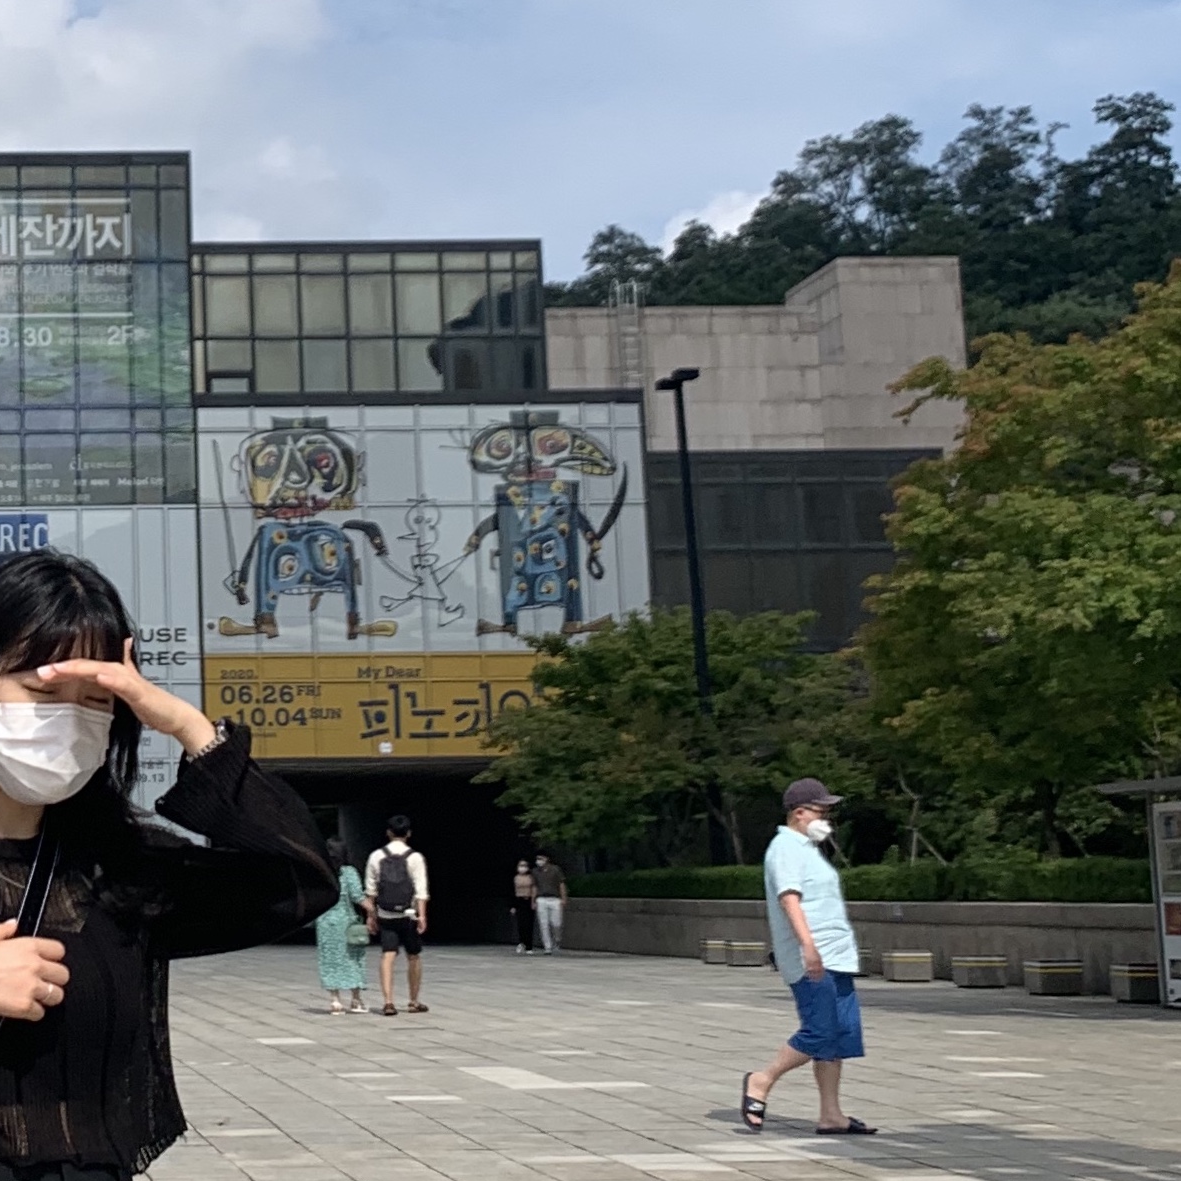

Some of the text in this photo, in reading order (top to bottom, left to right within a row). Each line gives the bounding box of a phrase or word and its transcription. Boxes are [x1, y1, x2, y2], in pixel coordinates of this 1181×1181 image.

[139, 628, 187, 642] USE
[139, 651, 187, 666] REC
[357, 665, 422, 680] My Dear
[220, 685, 294, 705] 06.26
[309, 708, 341, 720] SUN
